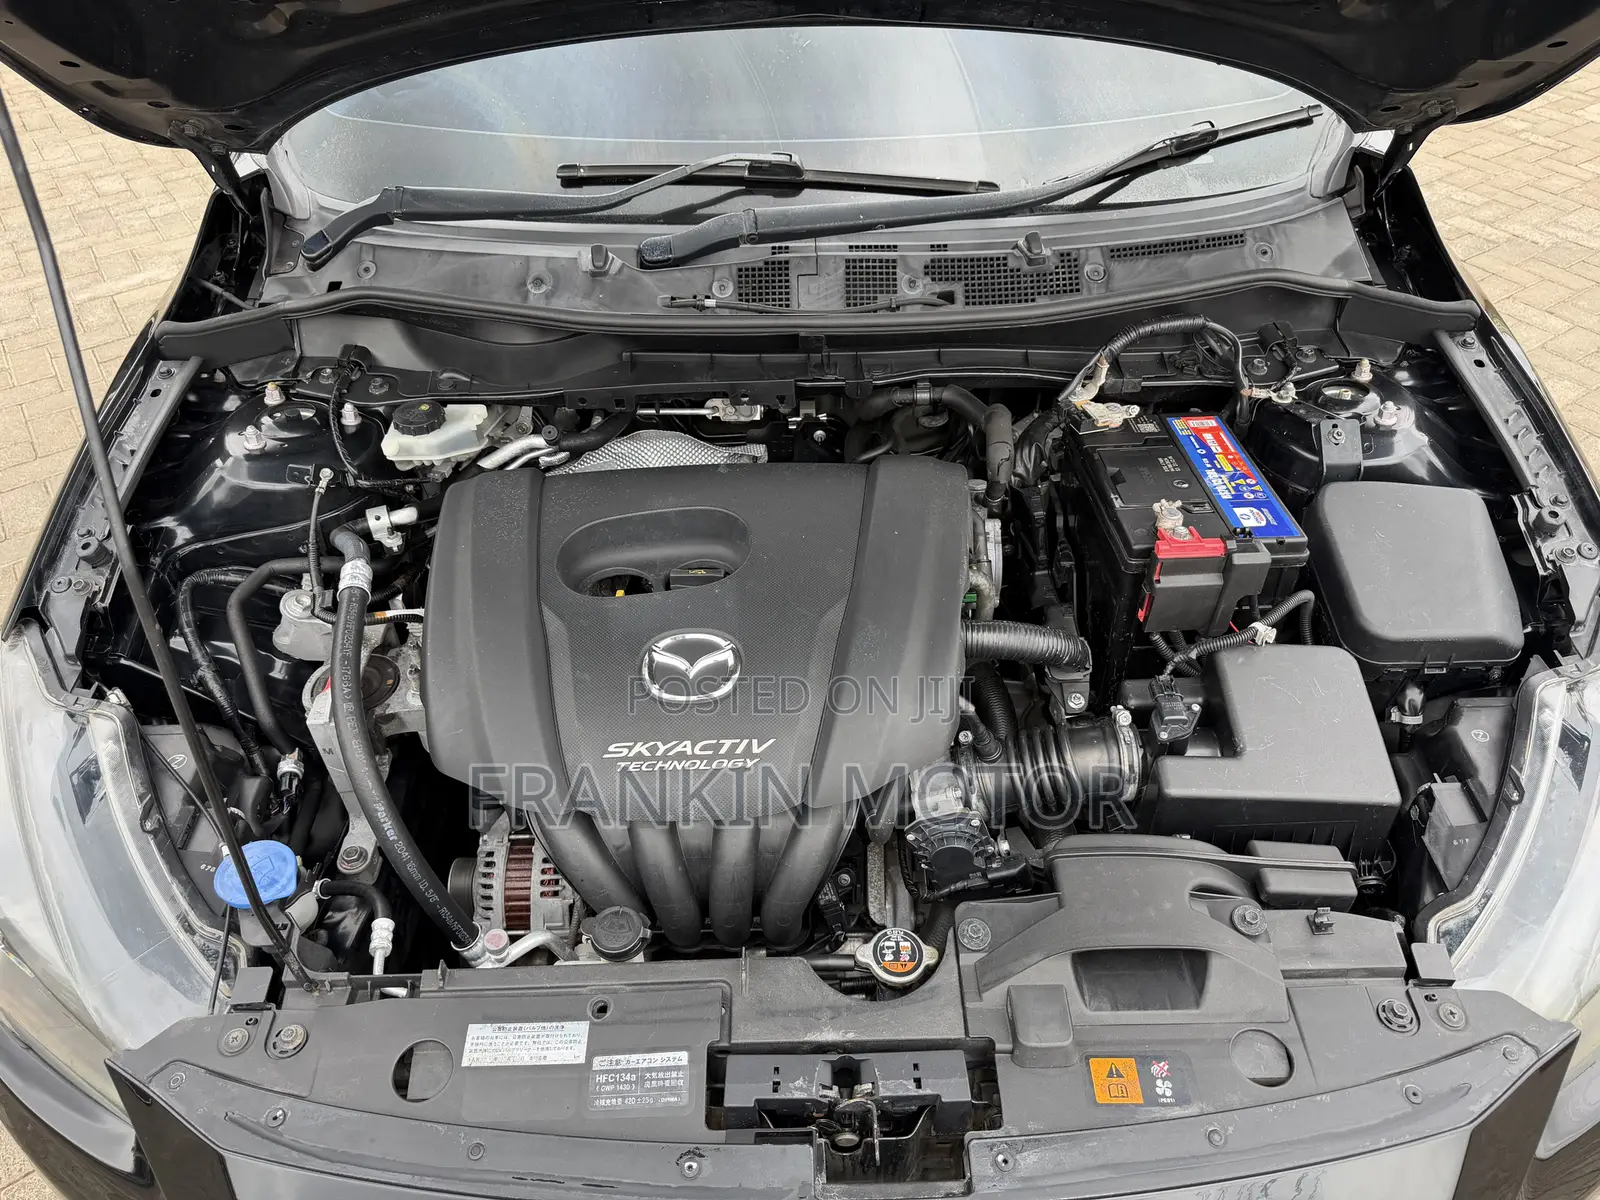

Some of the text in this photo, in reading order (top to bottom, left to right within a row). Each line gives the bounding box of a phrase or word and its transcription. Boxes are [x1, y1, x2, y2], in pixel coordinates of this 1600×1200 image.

[602, 738, 777, 758] SKYACTIV
[616, 757, 761, 772] TECHNOLOGY
[394, 841, 411, 862] 2041
[595, 1072, 637, 1083] HFC134a
